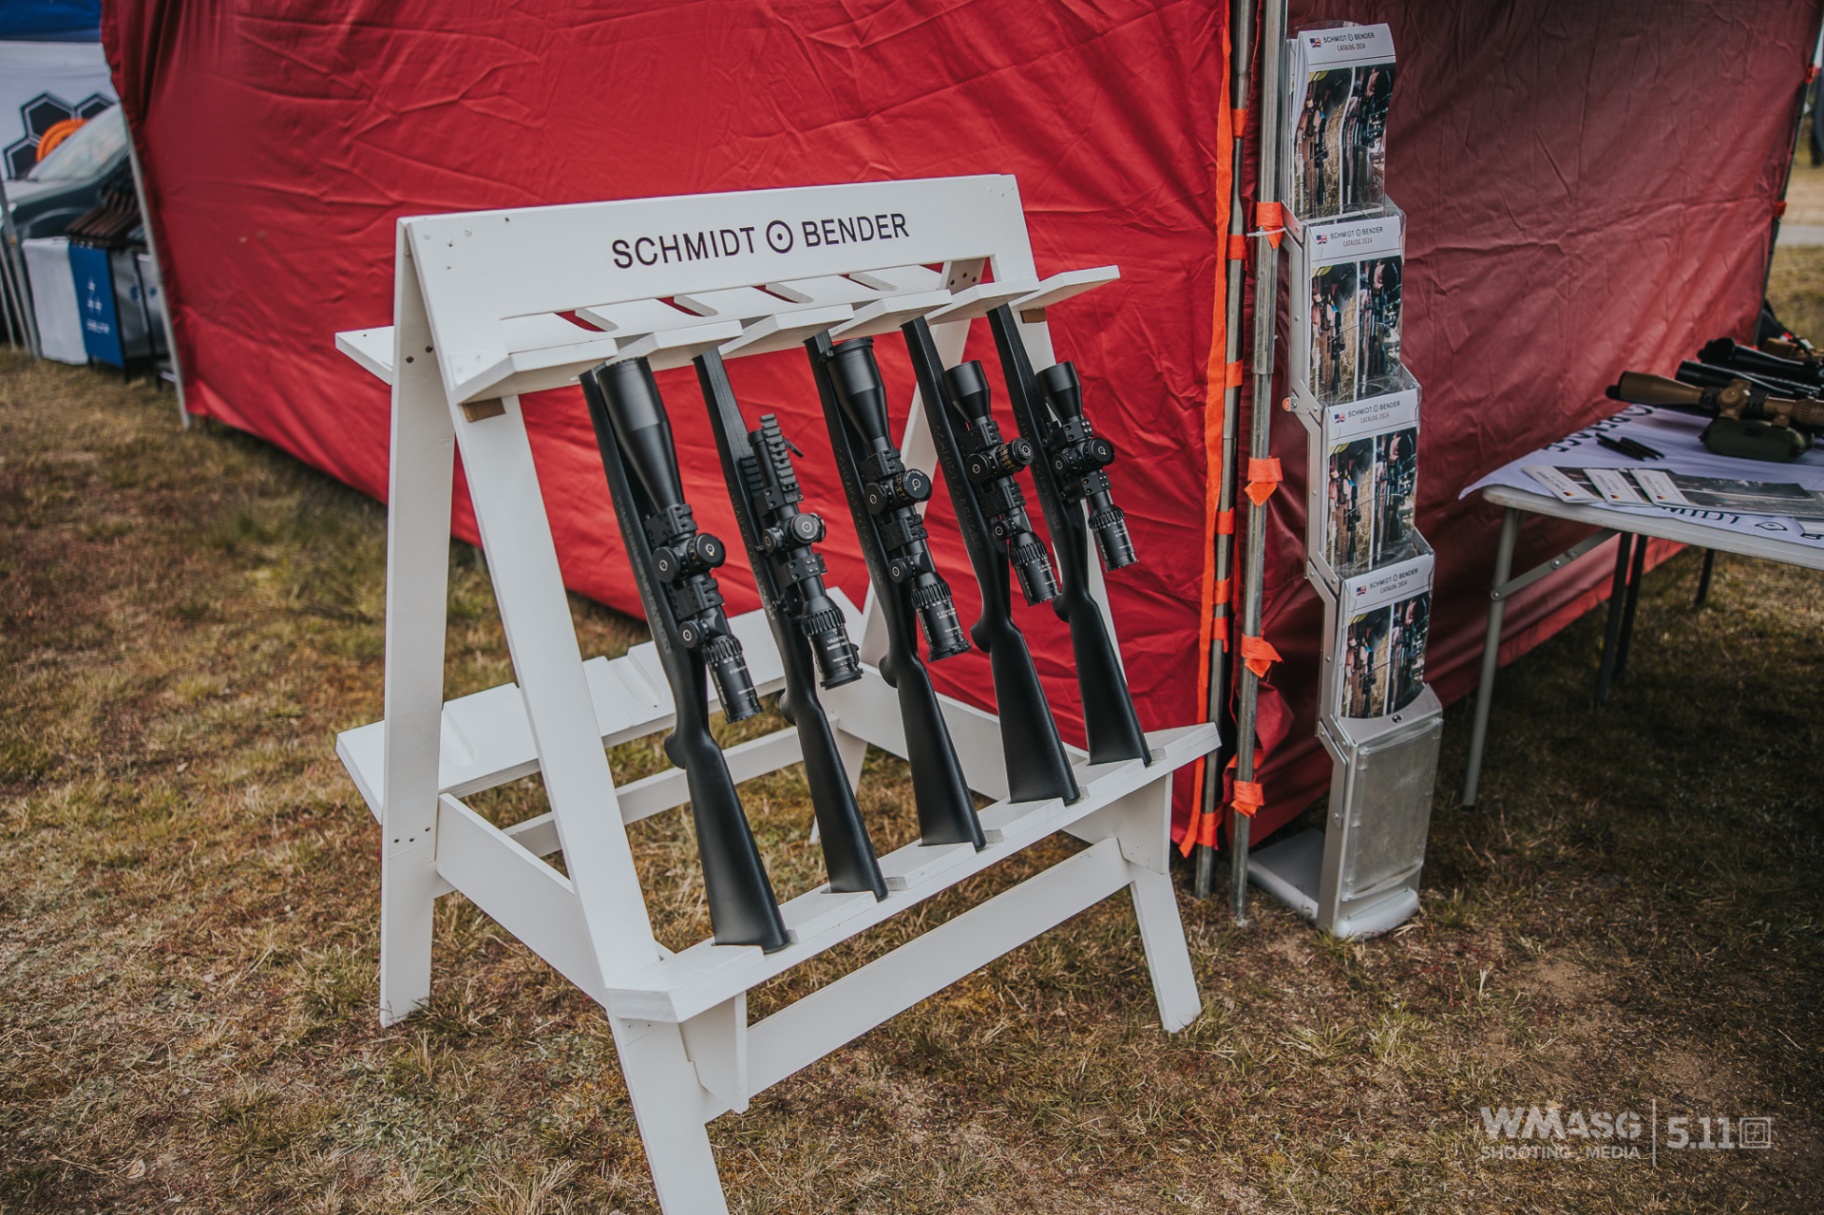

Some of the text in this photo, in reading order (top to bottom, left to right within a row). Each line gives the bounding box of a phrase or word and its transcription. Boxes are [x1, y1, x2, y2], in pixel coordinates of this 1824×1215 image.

[1323, 32, 1375, 43] SCHMIDT BENDER
[611, 212, 910, 269] SCHMIDT BENDER
[1330, 226, 1383, 239] SCHMIDT BENDER
[1348, 401, 1400, 418] SCHMIDT BENDER
[1369, 568, 1418, 589] SCHMIDT BENDER
